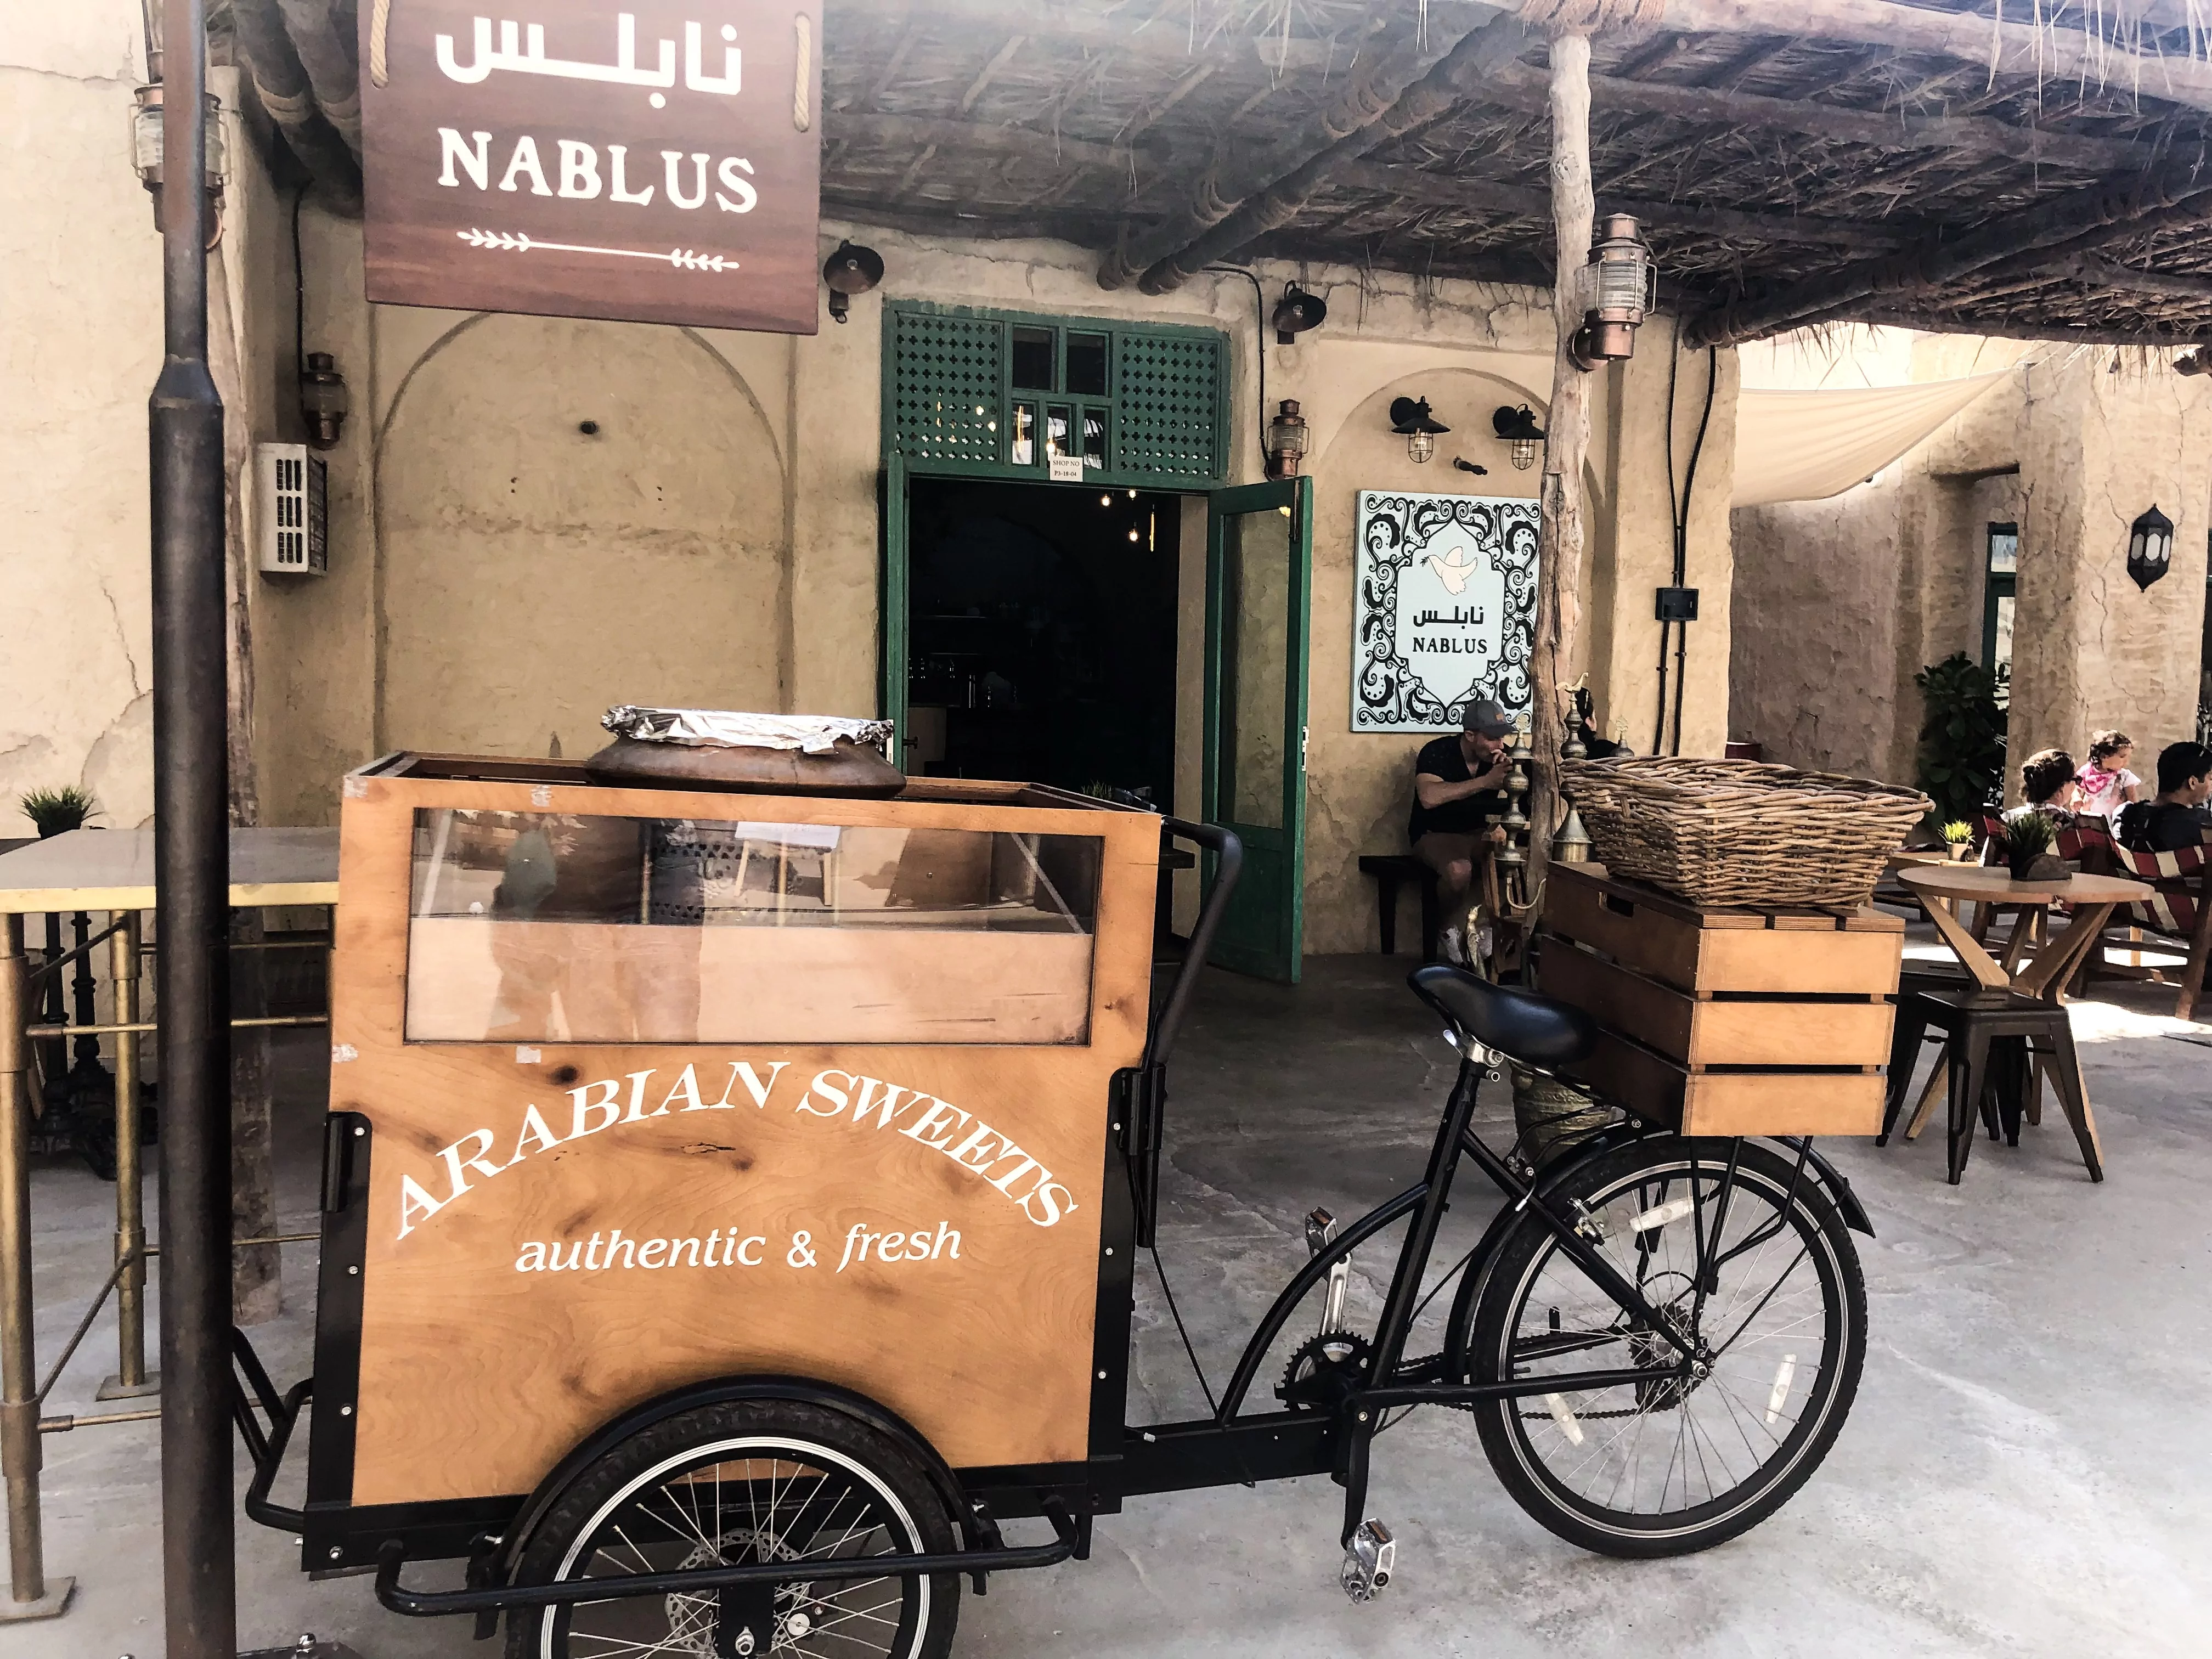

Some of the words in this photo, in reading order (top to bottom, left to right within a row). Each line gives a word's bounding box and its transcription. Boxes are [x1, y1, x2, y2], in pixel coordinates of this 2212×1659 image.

[436, 12, 742, 109] نابلس
[437, 127, 758, 213] NABLUS
[1412, 637, 1487, 654] NABLUS
[1413, 606, 1484, 630] نابلس
[396, 1060, 791, 1240] ARABIAN
[794, 1069, 1079, 1227] SWEETS
[515, 1226, 766, 1272] authentic
[787, 1230, 817, 1268] &
[835, 1220, 962, 1273] fresh
